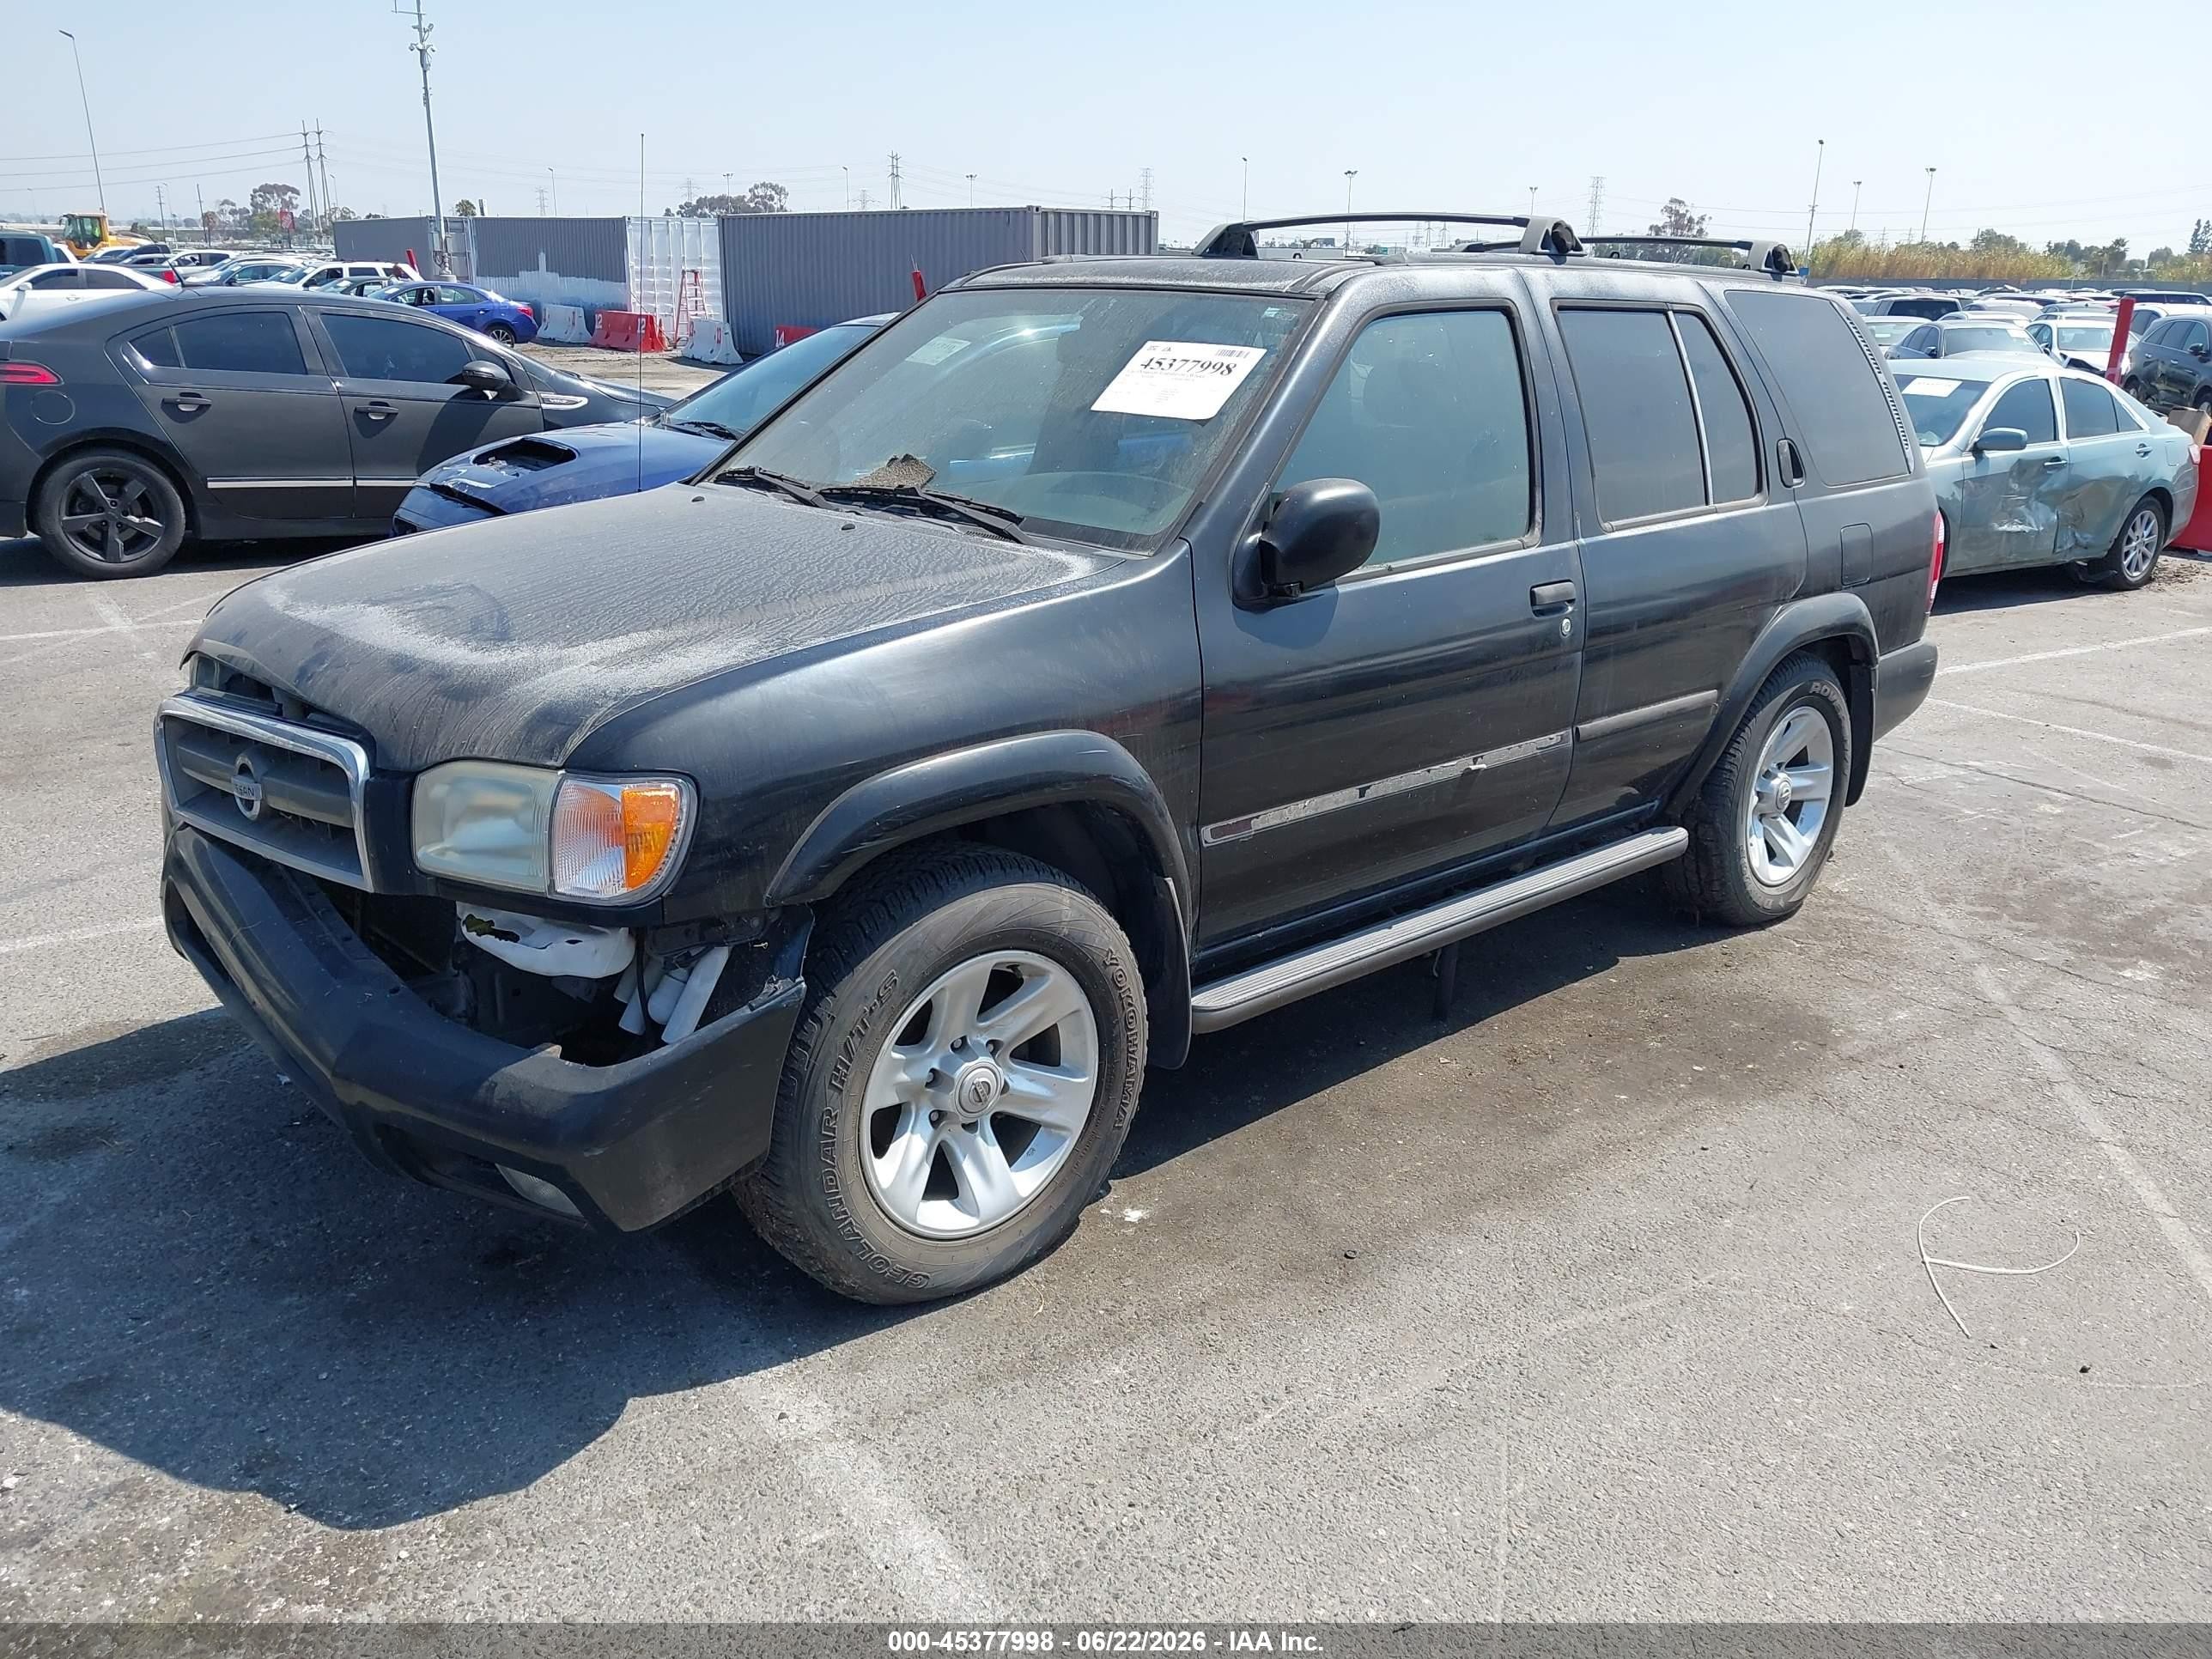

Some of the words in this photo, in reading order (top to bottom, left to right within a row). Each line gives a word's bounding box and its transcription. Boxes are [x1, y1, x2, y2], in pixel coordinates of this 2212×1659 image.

[595, 313, 602, 330] 12
[637, 318, 646, 334] 12
[775, 329, 785, 348] 14
[1140, 357, 1237, 376] 45377998
[1103, 948, 1139, 1130] YOKOHAMA
[820, 1107, 931, 1289] GEOLANDAR
